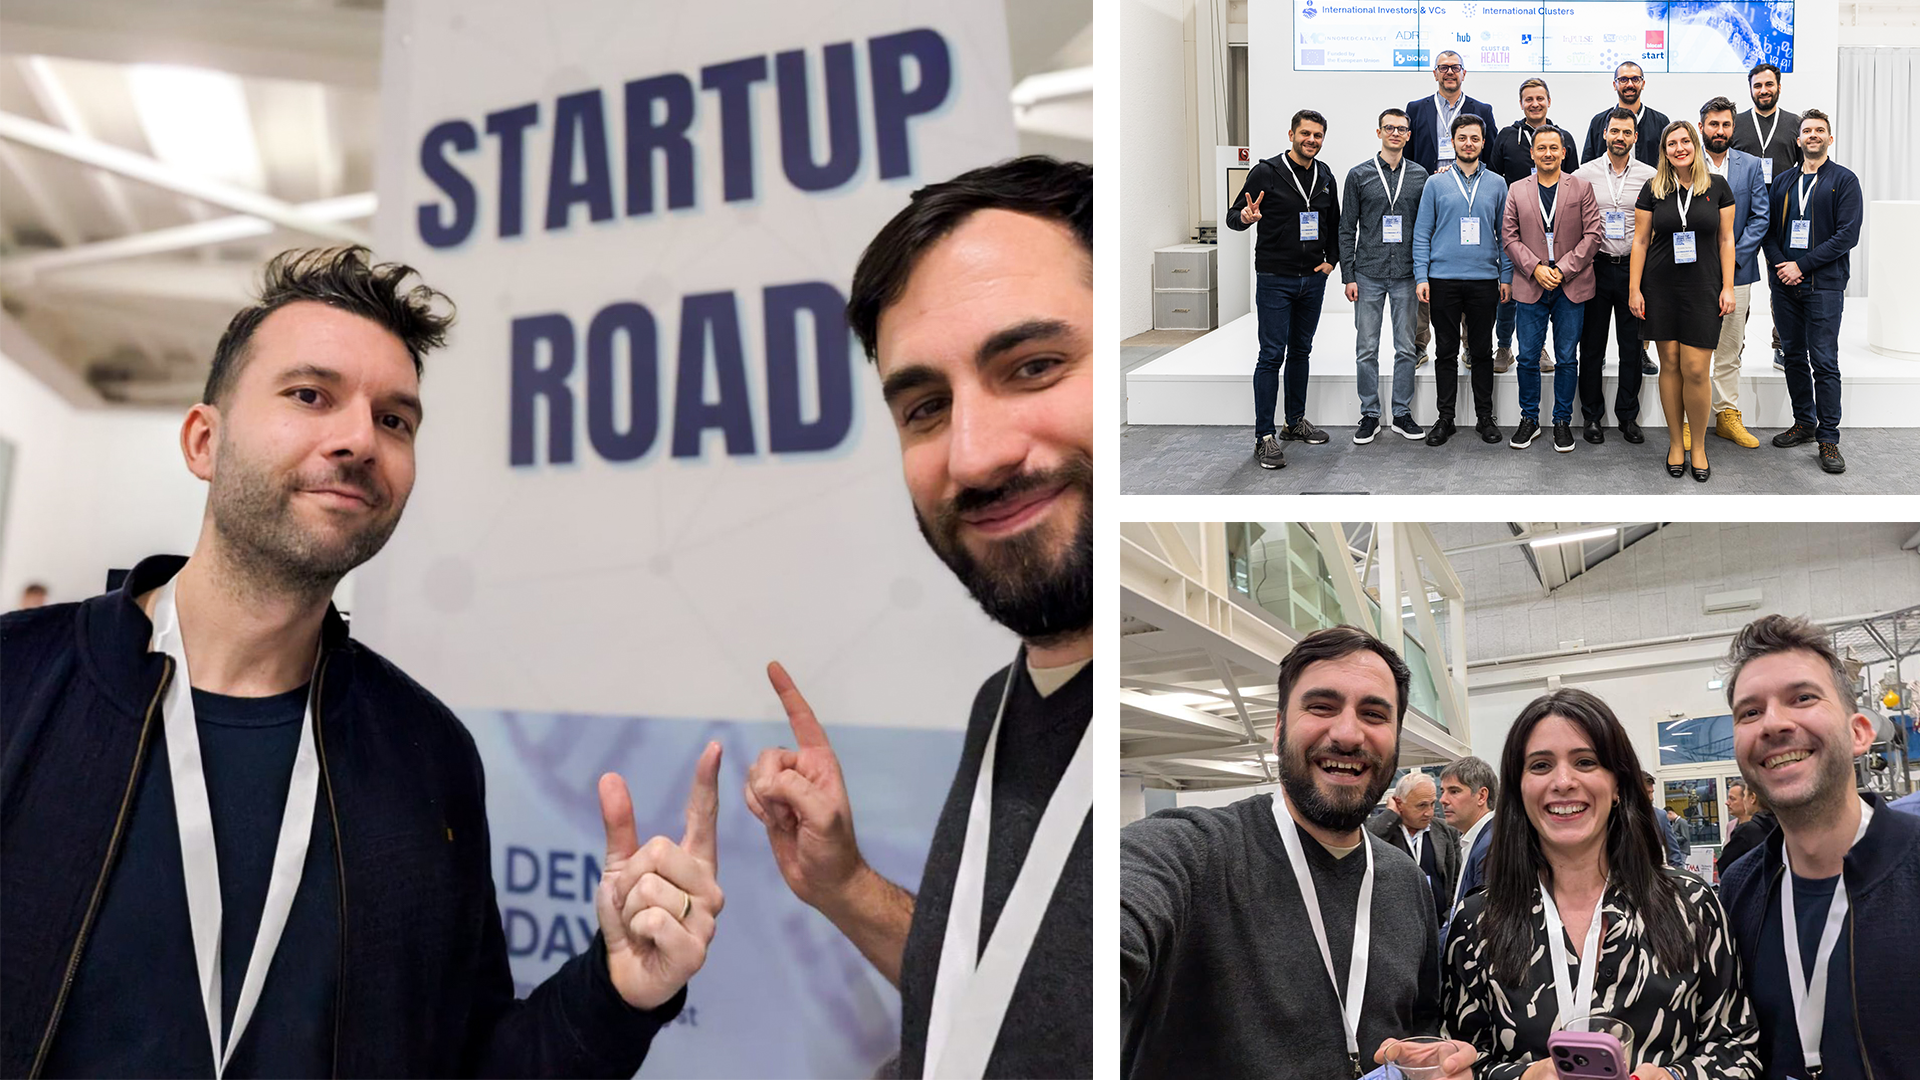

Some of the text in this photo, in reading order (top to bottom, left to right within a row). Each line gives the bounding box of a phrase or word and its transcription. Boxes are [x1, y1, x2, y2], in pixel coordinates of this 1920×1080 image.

[1322, 6, 1446, 15] International Investors & VCs
[1482, 7, 1575, 16] International Clusters
[1456, 32, 1471, 43] hub
[1480, 51, 1510, 64] HEALTH
[417, 27, 954, 250] STARTUP
[508, 280, 856, 468] ROAD
